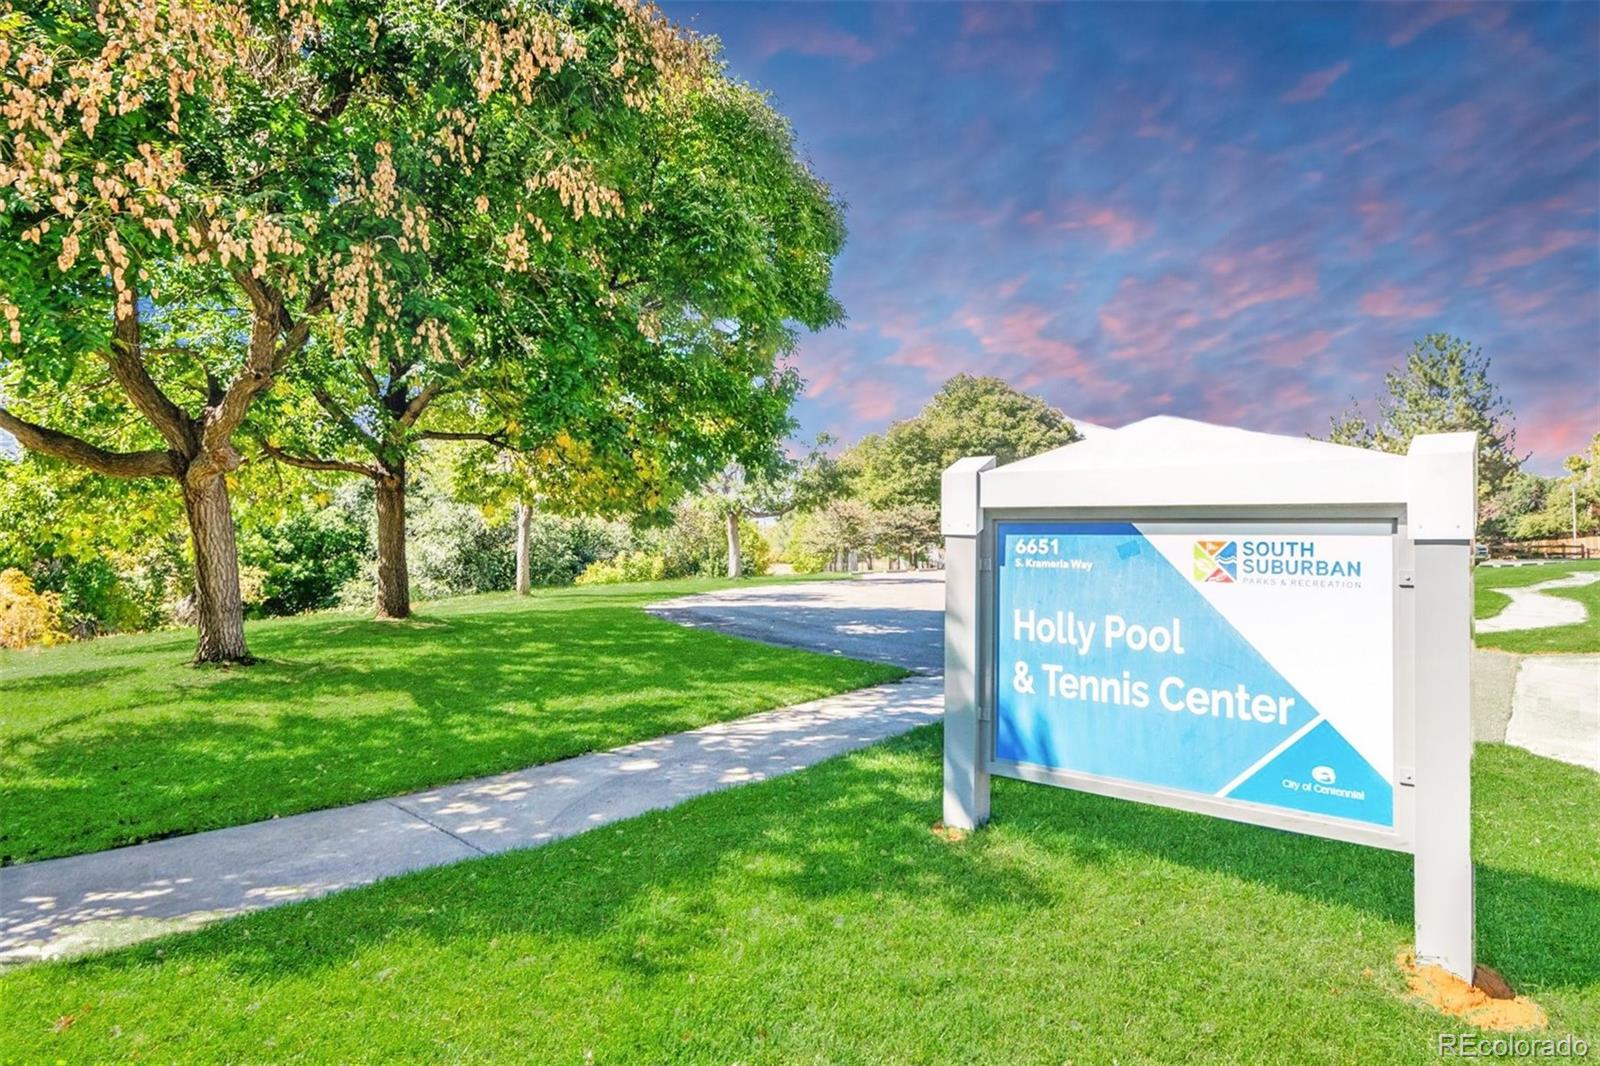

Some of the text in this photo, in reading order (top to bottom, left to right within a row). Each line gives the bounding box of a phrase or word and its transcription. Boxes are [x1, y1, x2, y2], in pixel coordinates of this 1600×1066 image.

[1015, 538, 1058, 555] 6651
[1243, 541, 1314, 557] SOUTH
[1015, 558, 1024, 568] S.
[1071, 559, 1094, 572] Way
[1243, 559, 1361, 577] SUBURBAN
[1243, 577, 1362, 589] PARKS & RECREATION
[1013, 608, 1185, 656] Holly Pool
[1012, 660, 1295, 725] & Tennis Center
[1282, 778, 1366, 801] City of Centennial
